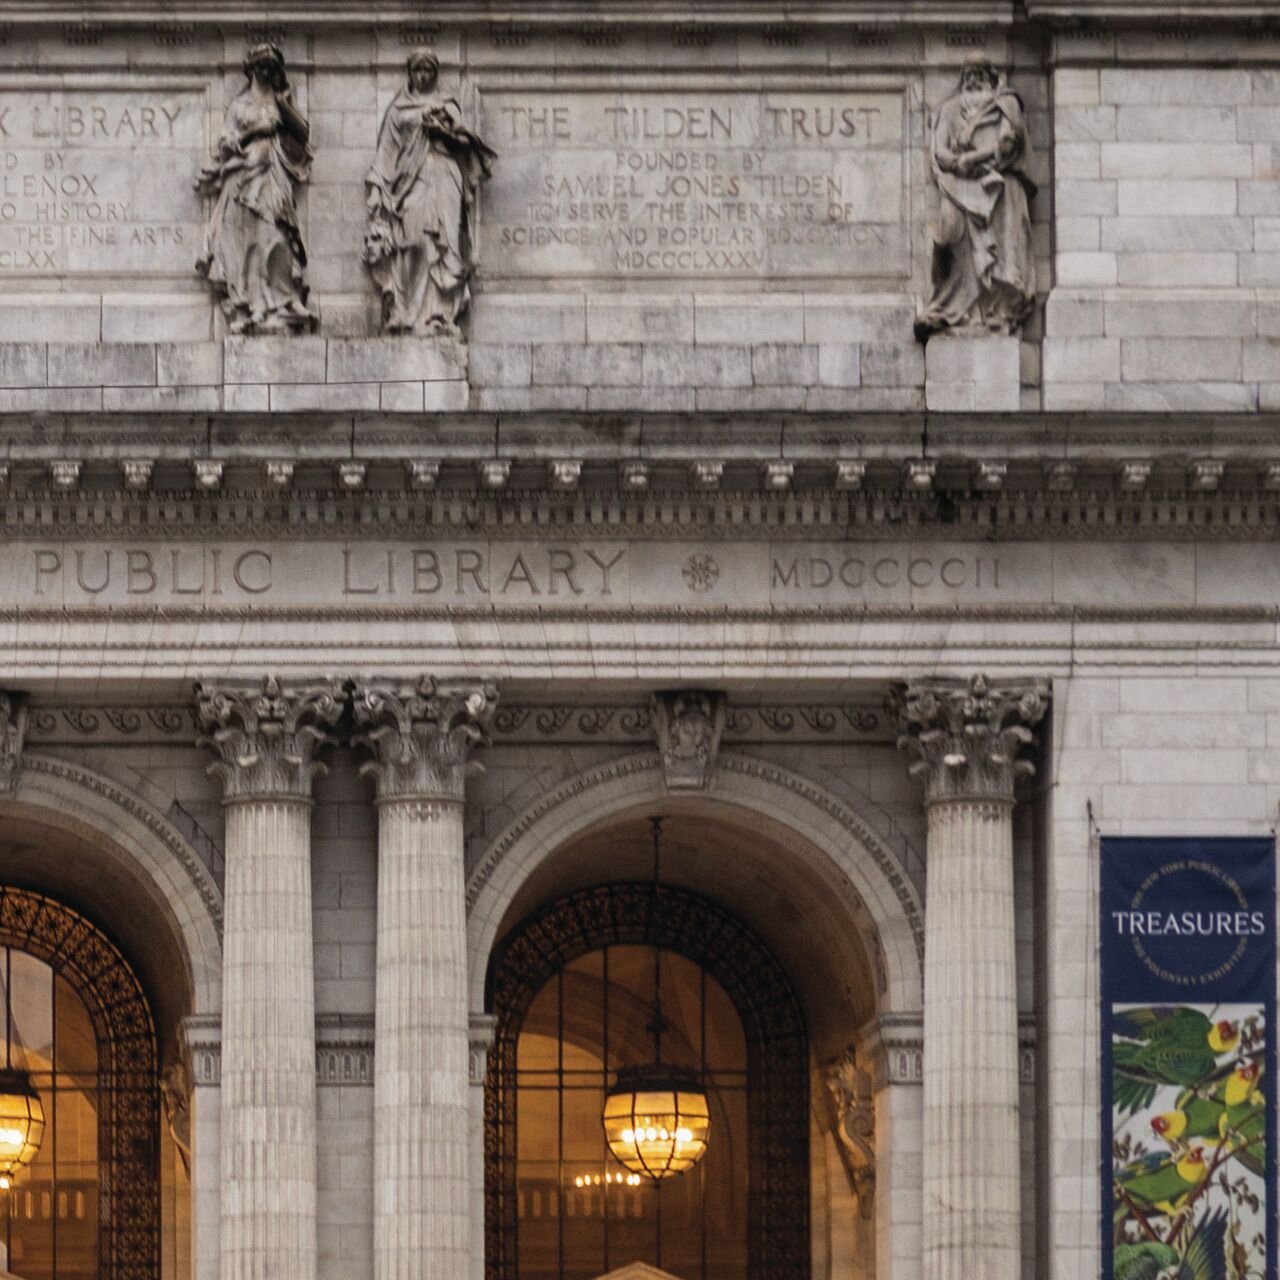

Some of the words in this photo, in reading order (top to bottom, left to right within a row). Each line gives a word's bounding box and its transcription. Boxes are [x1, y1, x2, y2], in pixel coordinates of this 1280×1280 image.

[32, 107, 182, 138] LIBRARY
[501, 107, 571, 139] THE
[604, 107, 732, 139] TILDEN
[765, 107, 881, 138] TRUST
[44, 152, 66, 170] BY
[616, 152, 718, 170] FOUNDED
[742, 153, 765, 170] BY
[3, 175, 97, 197] LENOX
[543, 175, 644, 198] SAMUEL
[655, 175, 740, 197] JONES
[753, 175, 842, 197] TILDEN
[568, 202, 629, 221] SERVE
[645, 203, 685, 221] THE
[700, 202, 814, 221] INTERESTS
[827, 203, 854, 221] OF
[13, 227, 54, 245] THE
[70, 227, 117, 245] FINE
[129, 227, 184, 245] ARTS
[500, 227, 592, 246] SCIENCE
[604, 227, 647, 246] AND
[658, 227, 753, 245] POPULAR
[766, 226, 885, 246] EDUCATION
[32, 550, 274, 595] PUBLIC
[341, 550, 628, 595] LIBRARY
[773, 557, 1000, 589] MDCCCCII
[1112, 911, 1265, 935] TREASURES
